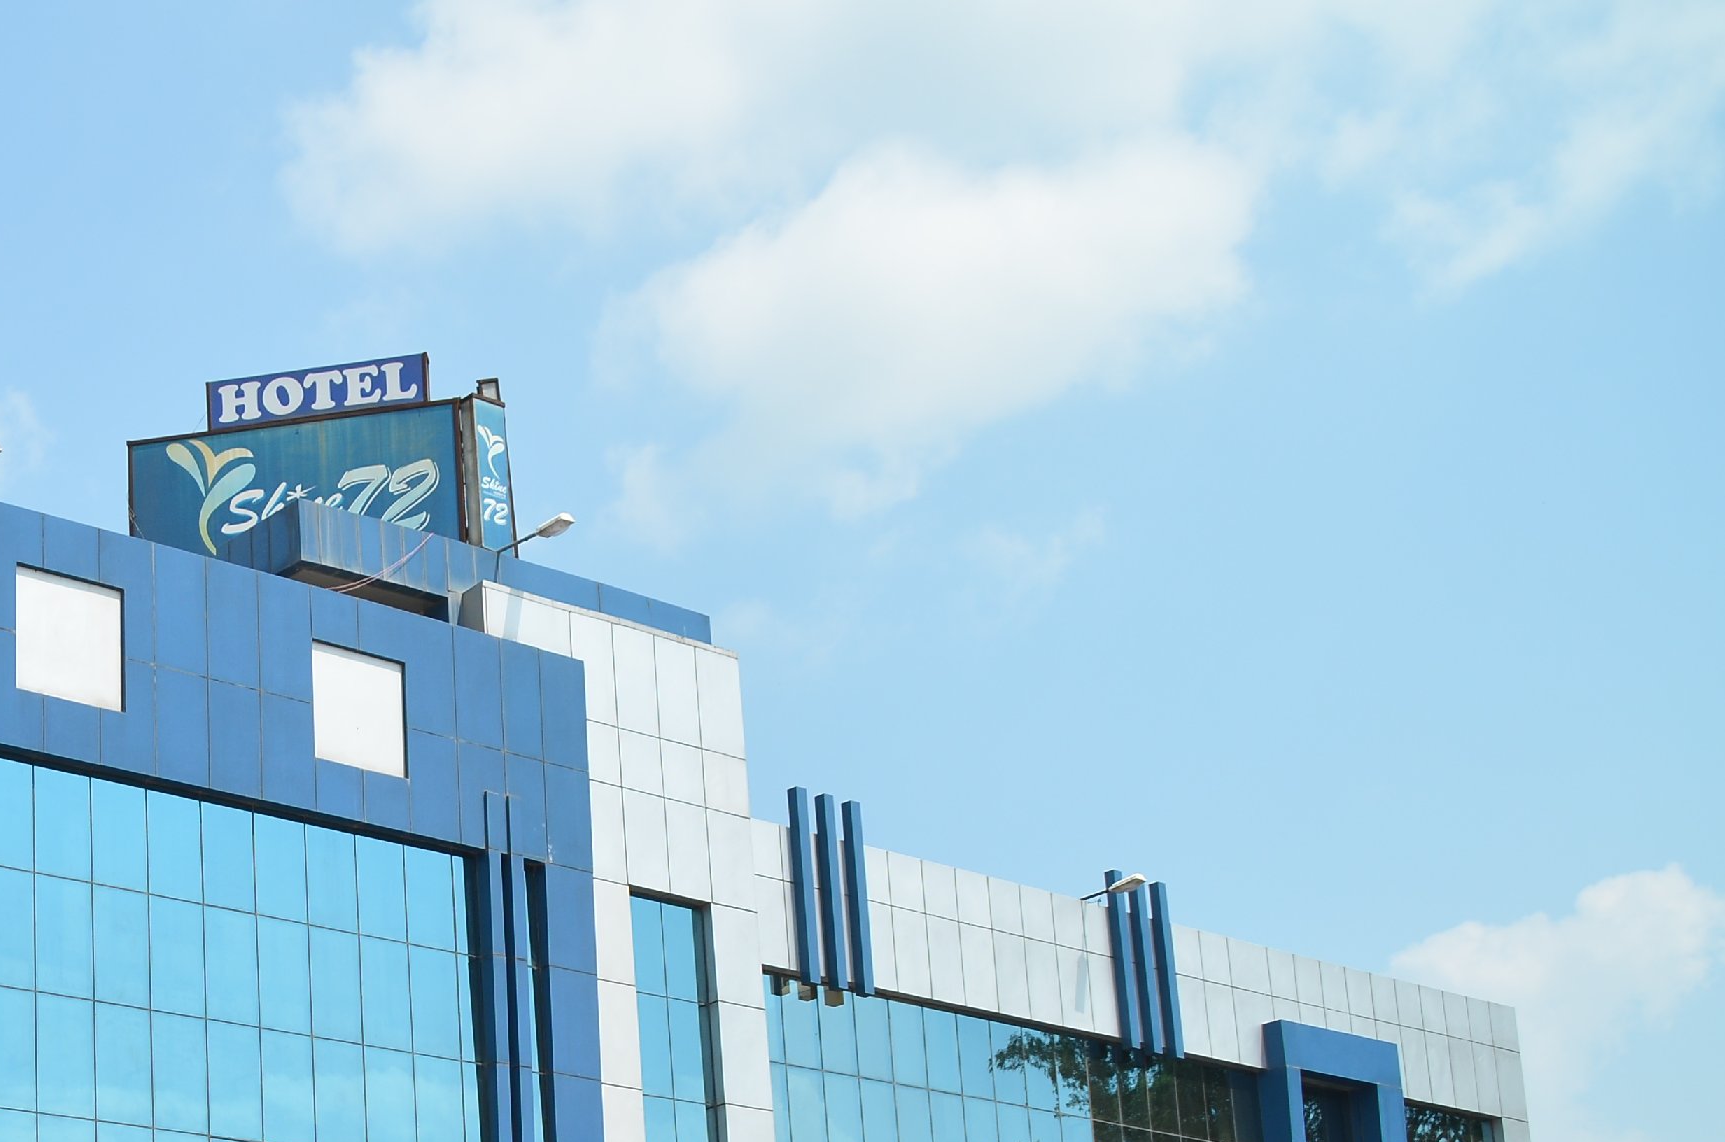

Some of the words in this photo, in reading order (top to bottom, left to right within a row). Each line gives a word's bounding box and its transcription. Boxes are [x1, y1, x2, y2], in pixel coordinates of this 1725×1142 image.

[217, 361, 418, 424] HOTEL
[338, 458, 440, 532] 72
[483, 498, 509, 526] 72
